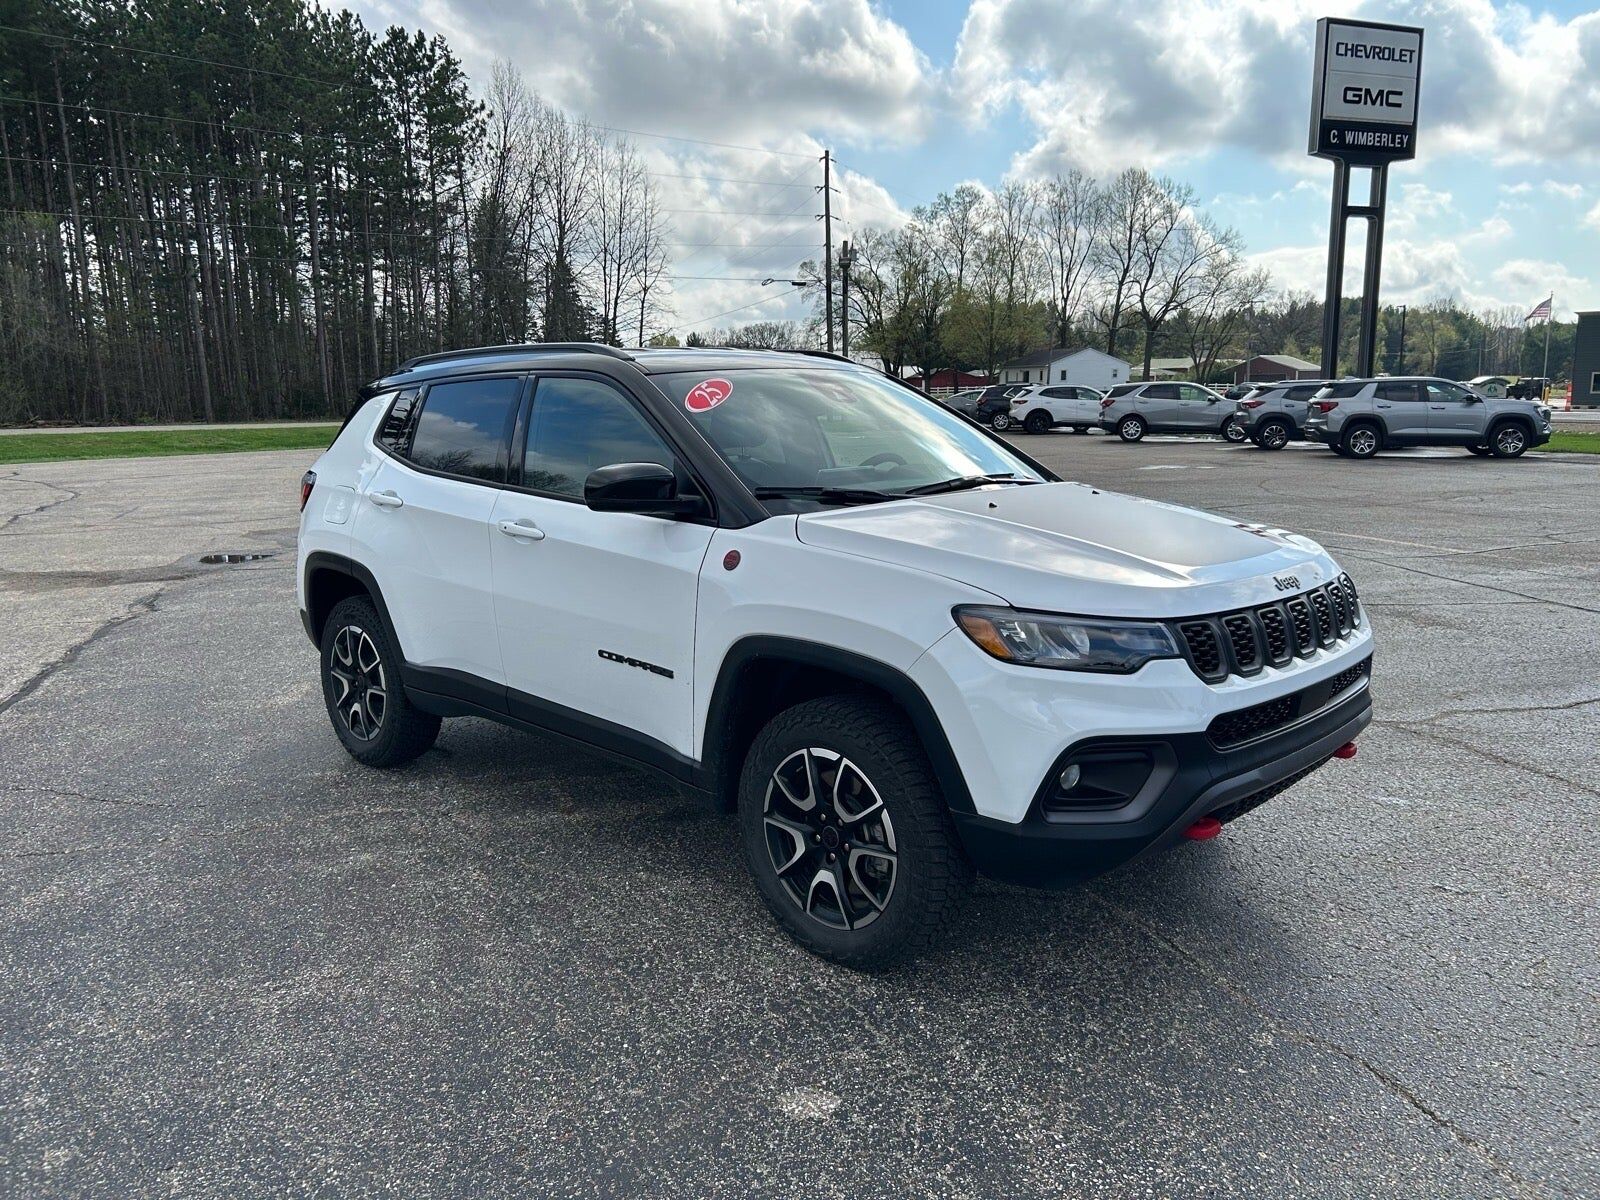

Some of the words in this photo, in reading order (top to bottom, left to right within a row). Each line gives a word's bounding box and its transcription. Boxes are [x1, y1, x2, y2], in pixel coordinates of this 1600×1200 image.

[1336, 41, 1415, 63] CHEVROLET
[1343, 86, 1403, 108] GMC
[1330, 129, 1340, 144] C.
[1345, 130, 1409, 148] WIMBERLEY
[695, 382, 723, 406] 25
[1273, 576, 1301, 591] Jeep
